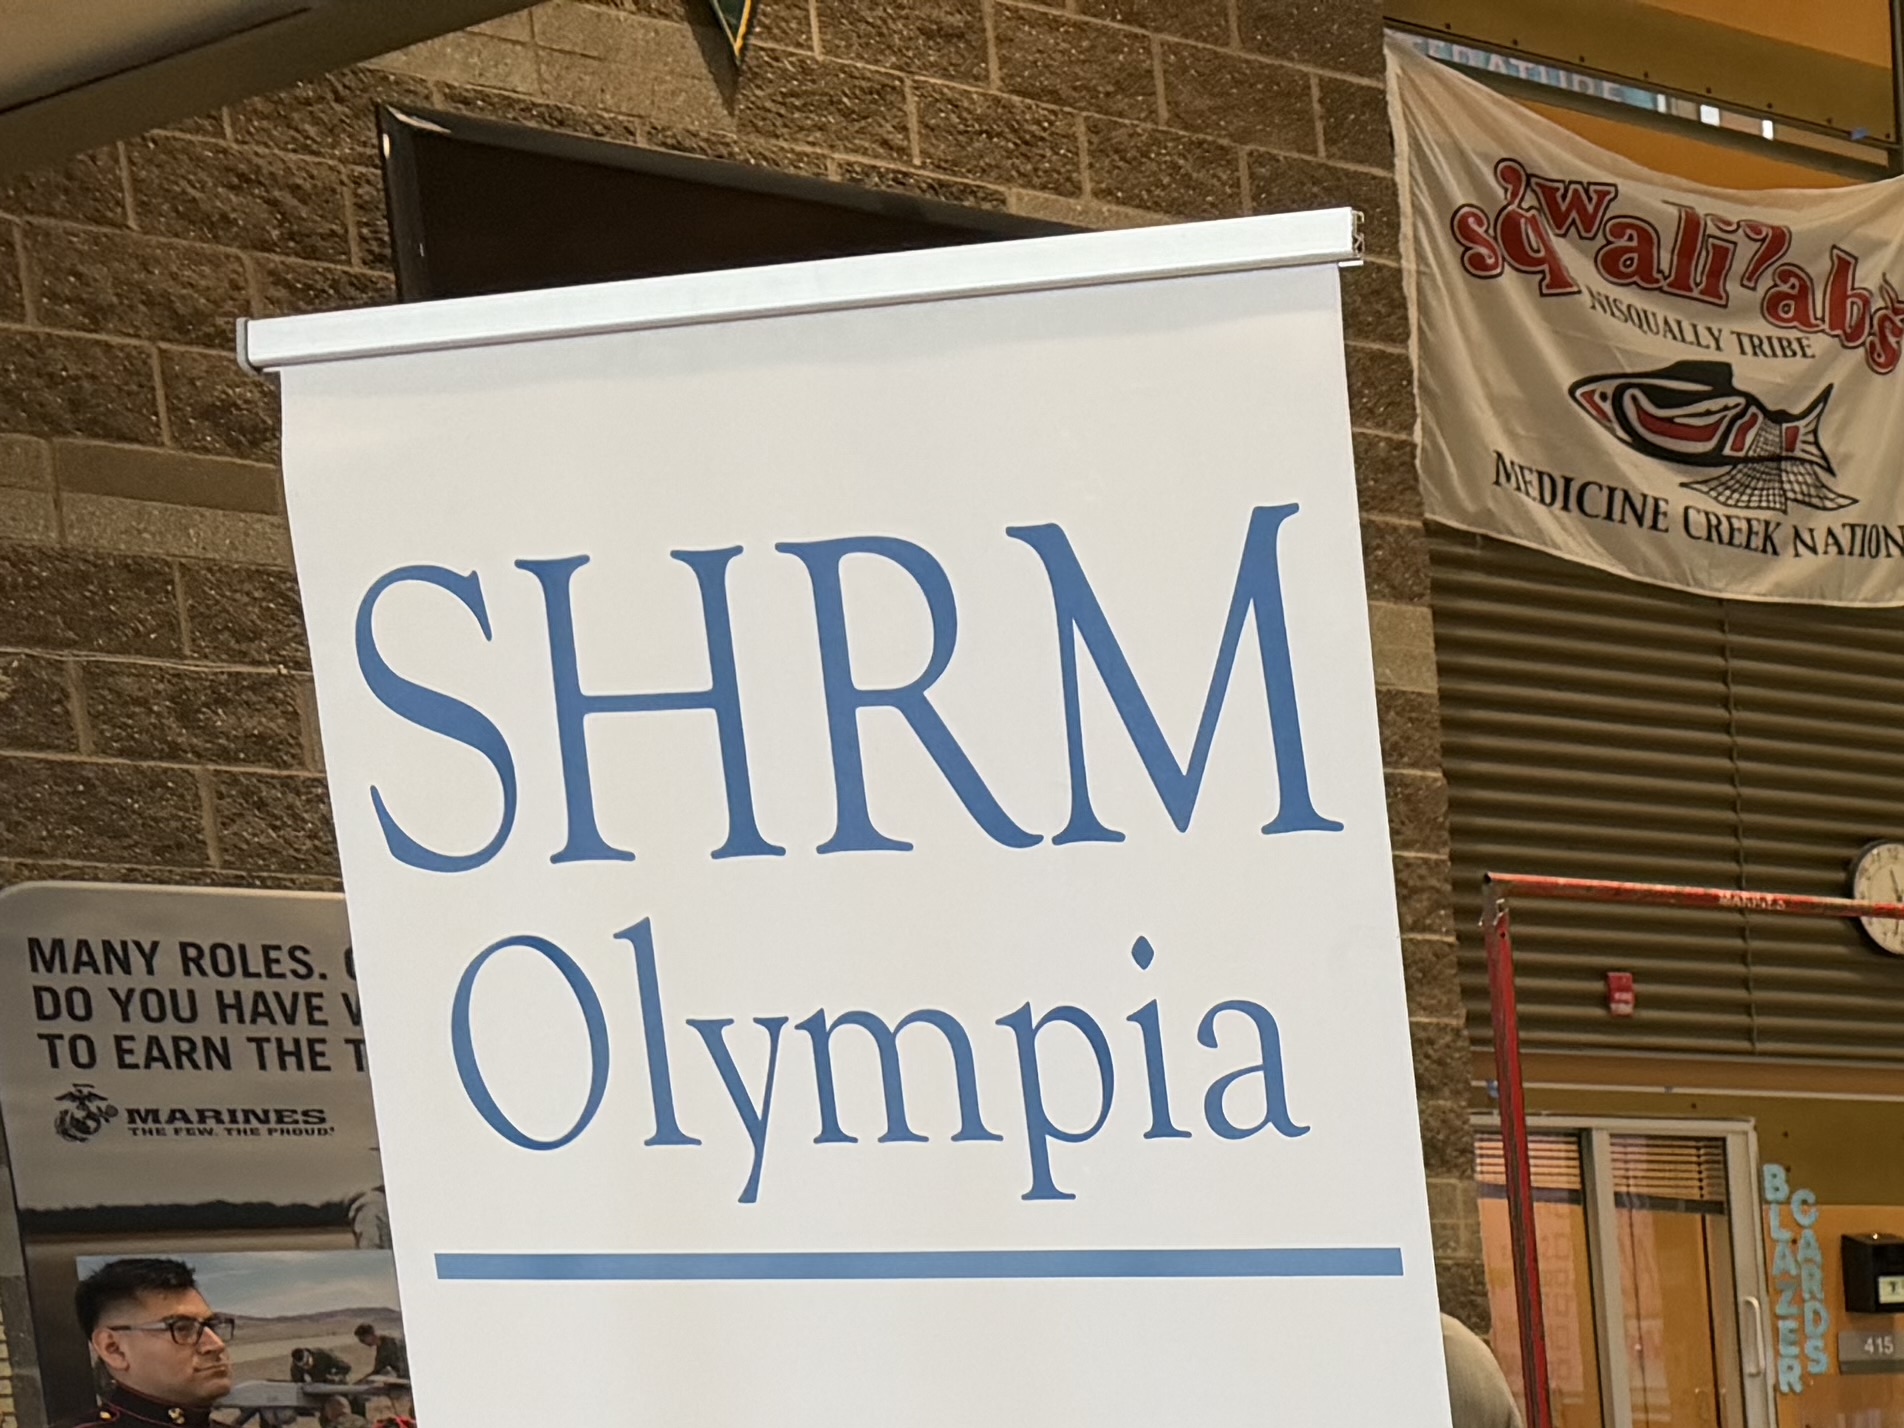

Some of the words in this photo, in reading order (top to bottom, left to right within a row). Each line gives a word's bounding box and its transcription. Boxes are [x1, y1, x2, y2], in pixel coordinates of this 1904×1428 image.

[1588, 285, 1725, 353] NISQUALLY
[1730, 329, 1817, 361] TRIBE
[1492, 450, 1670, 534] MEDICINE
[1682, 505, 1782, 558] CREEK
[355, 502, 1343, 873] SHRM
[28, 937, 160, 977] MANY
[179, 941, 328, 981] ROLES.
[32, 985, 93, 1023] DO
[108, 986, 199, 1024] YOU
[216, 990, 329, 1027] HAVE
[37, 1033, 98, 1070] TO
[113, 1034, 232, 1071] EARN
[246, 1037, 332, 1072] THE
[451, 916, 1311, 1204] Olympia
[126, 1107, 327, 1126] MARINES
[1763, 1163, 1803, 1393] BLAZER
[1791, 1188, 1830, 1375] CARDS
[1864, 1336, 1894, 1356] 415
